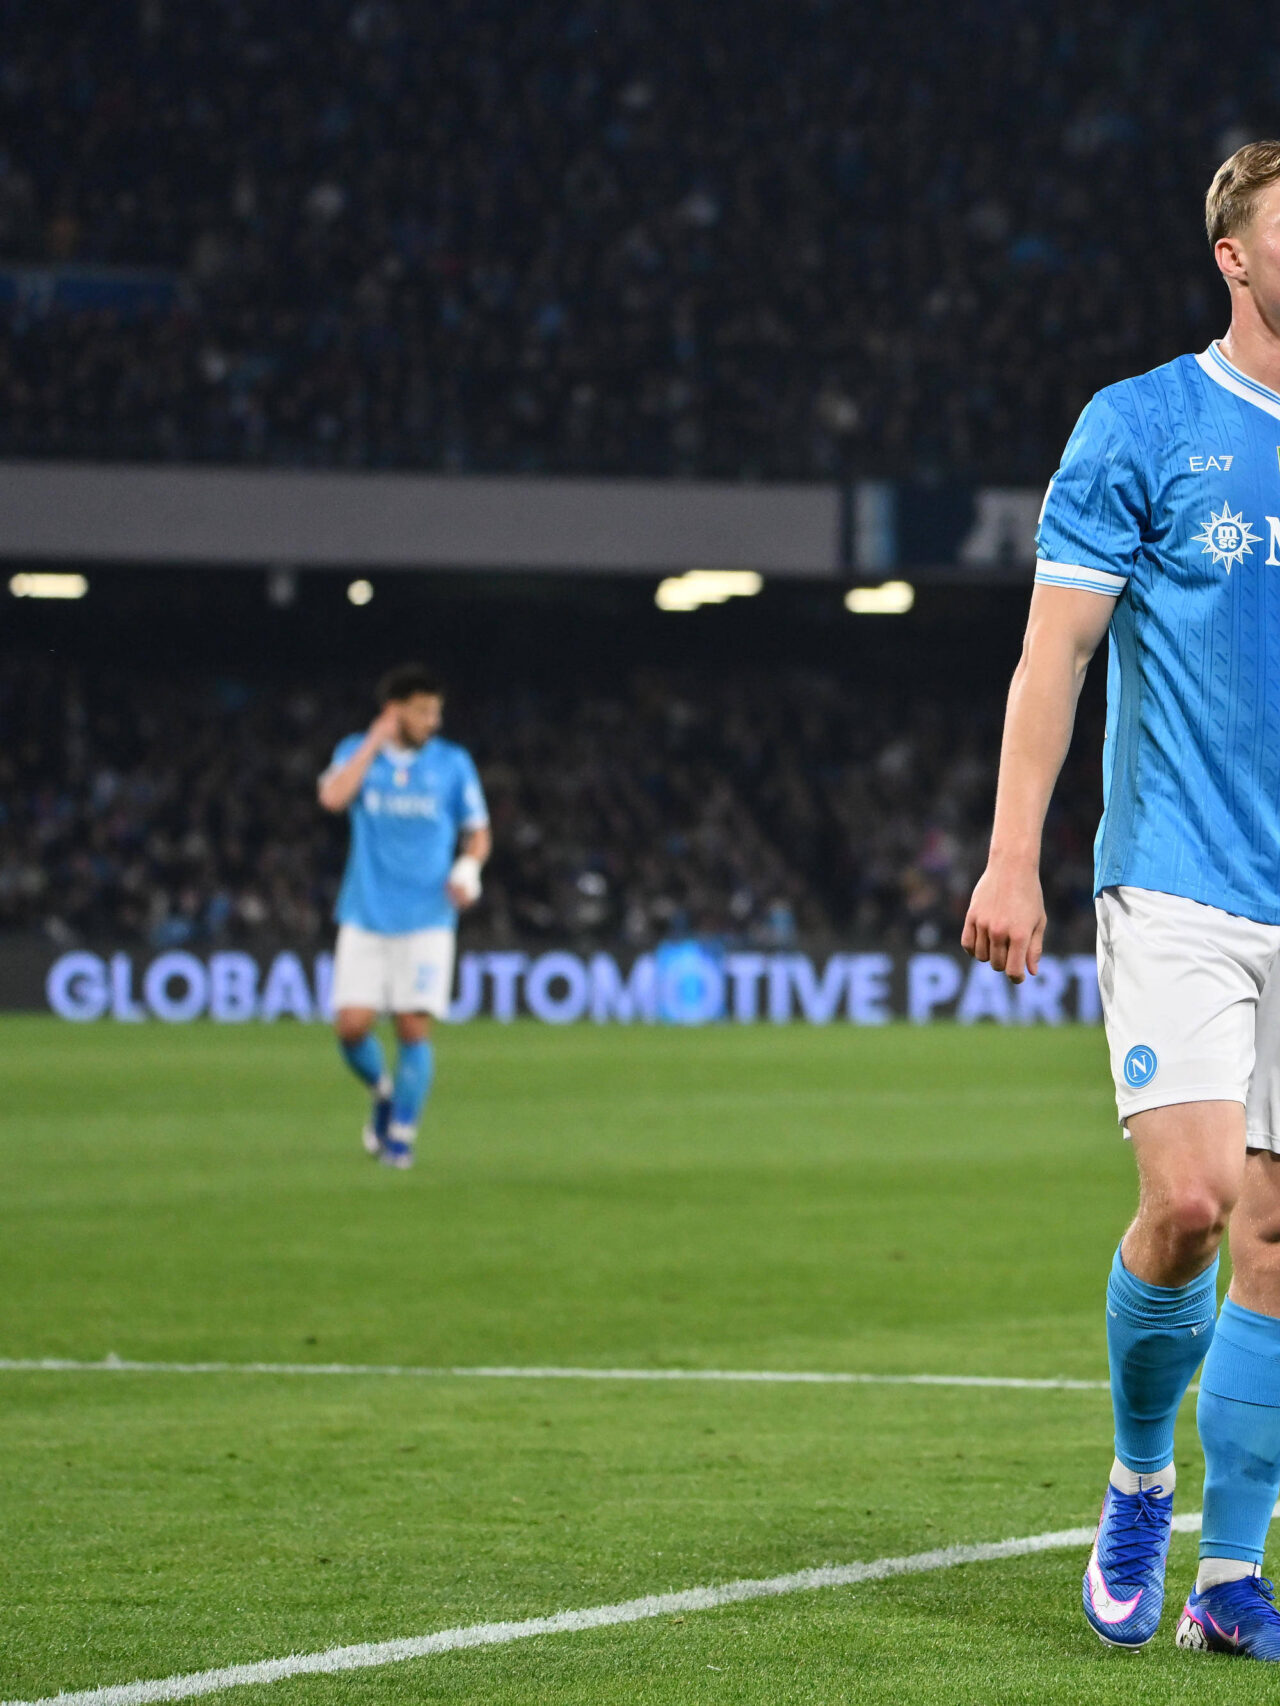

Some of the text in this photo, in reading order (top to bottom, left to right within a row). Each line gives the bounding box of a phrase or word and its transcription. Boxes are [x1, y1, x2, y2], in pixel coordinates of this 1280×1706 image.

[1189, 455, 1234, 472] EA7
[447, 952, 889, 1024] UTOMOTIVE
[1131, 1055, 1147, 1078] N
